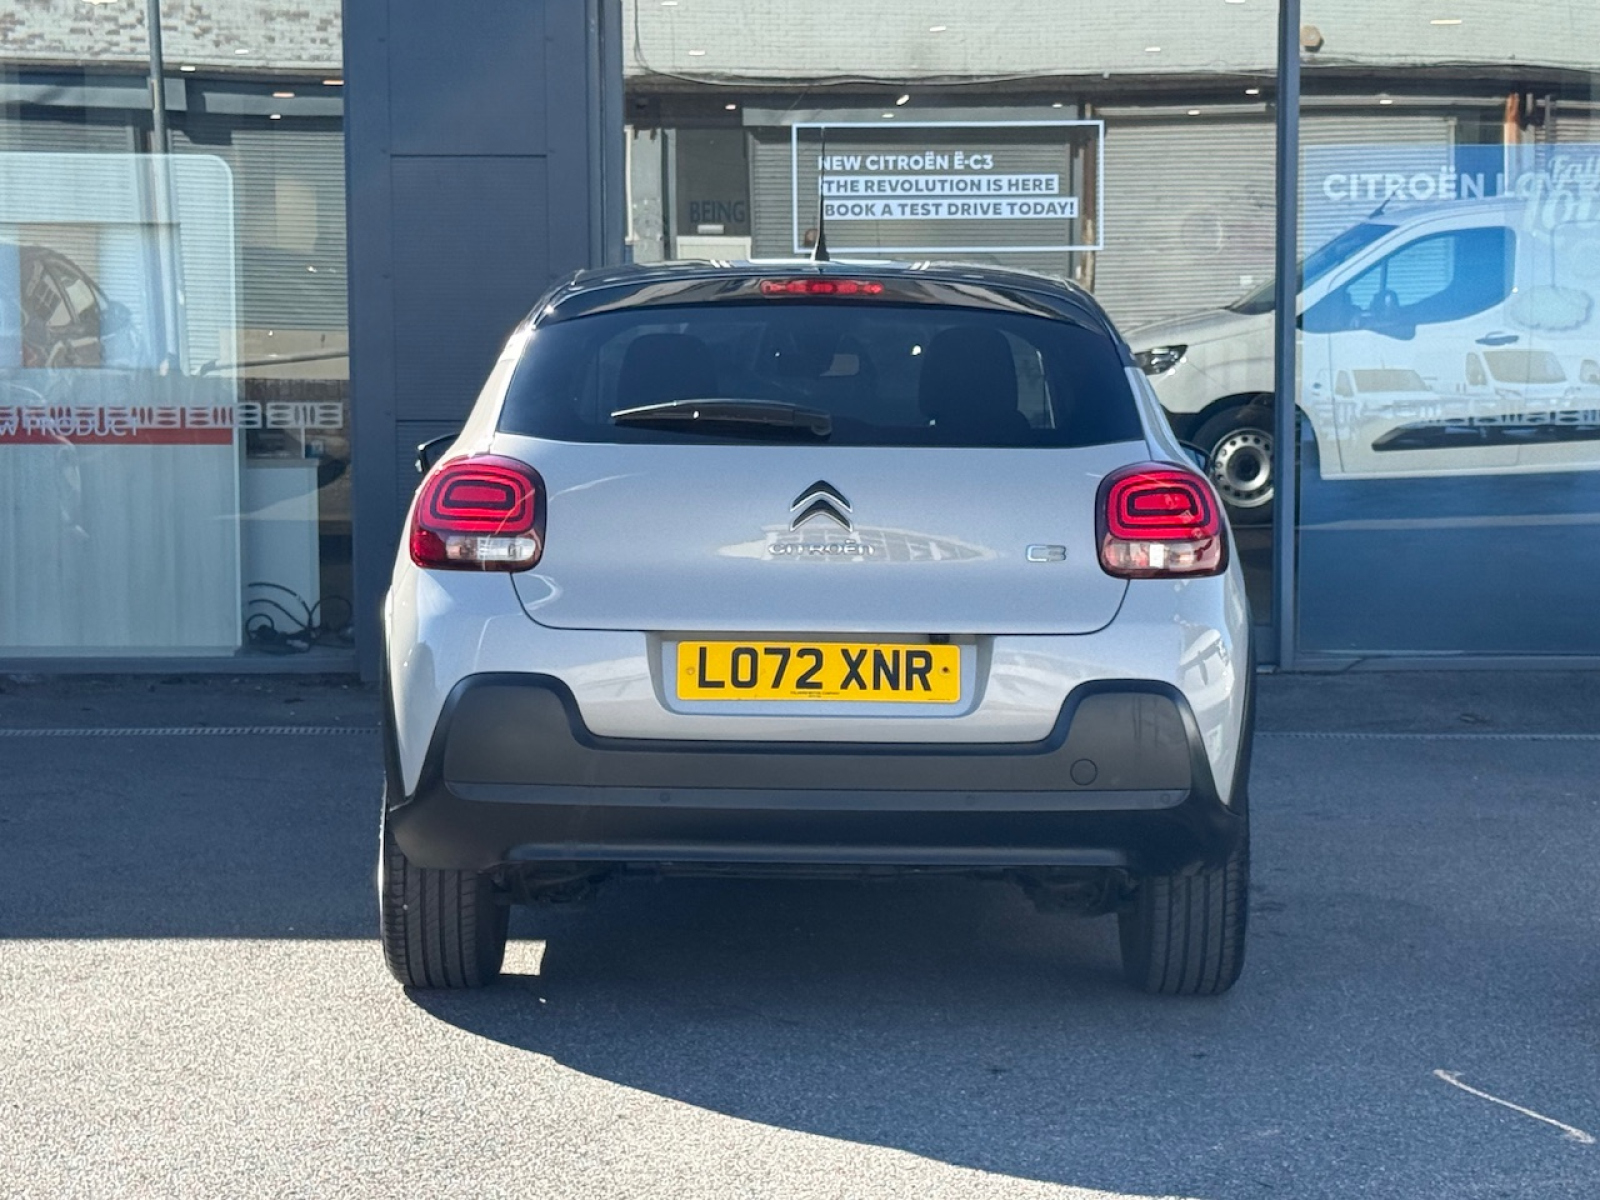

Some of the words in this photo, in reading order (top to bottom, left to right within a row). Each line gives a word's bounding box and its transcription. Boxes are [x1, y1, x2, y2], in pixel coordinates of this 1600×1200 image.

[818, 155, 861, 170] NEW
[865, 151, 949, 170] CITROËN
[953, 150, 994, 170] Ë-C3
[826, 179, 860, 193] THE
[864, 178, 982, 193] REVOLUTION
[986, 178, 1003, 192] IS
[1008, 177, 1055, 192] HERE
[1323, 165, 1484, 200] CITROËN
[689, 200, 746, 223] BEING
[825, 203, 876, 217] BOOK
[880, 203, 894, 217] A
[897, 202, 943, 217] TEST
[949, 201, 1002, 216] DRIVE
[1008, 201, 1074, 216] TODAY!
[27, 417, 139, 436] PRODUCT
[1025, 544, 1067, 562] C3
[698, 646, 825, 690] LO72
[840, 648, 932, 691] XNR
